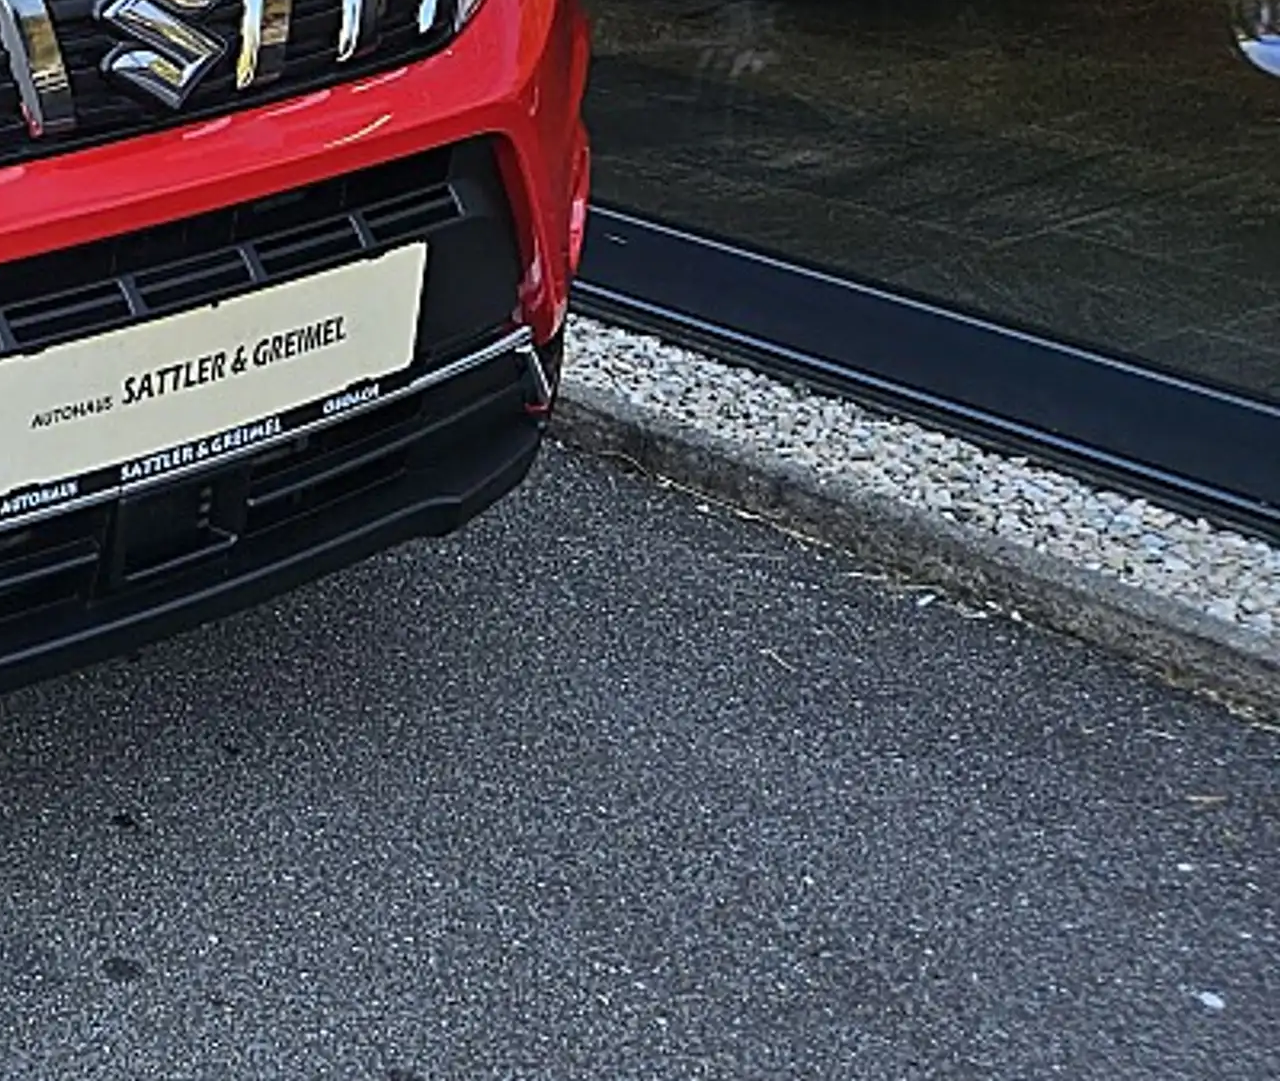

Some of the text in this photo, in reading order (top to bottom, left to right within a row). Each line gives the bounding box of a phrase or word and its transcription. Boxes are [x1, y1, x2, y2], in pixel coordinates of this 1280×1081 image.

[32, 316, 346, 429] AUTOHAUS SATTLER & GREIMEL
[0, 480, 78, 516] AUTOHAUS
[120, 447, 194, 481] SATTLER
[211, 418, 281, 452] GREIMEL
